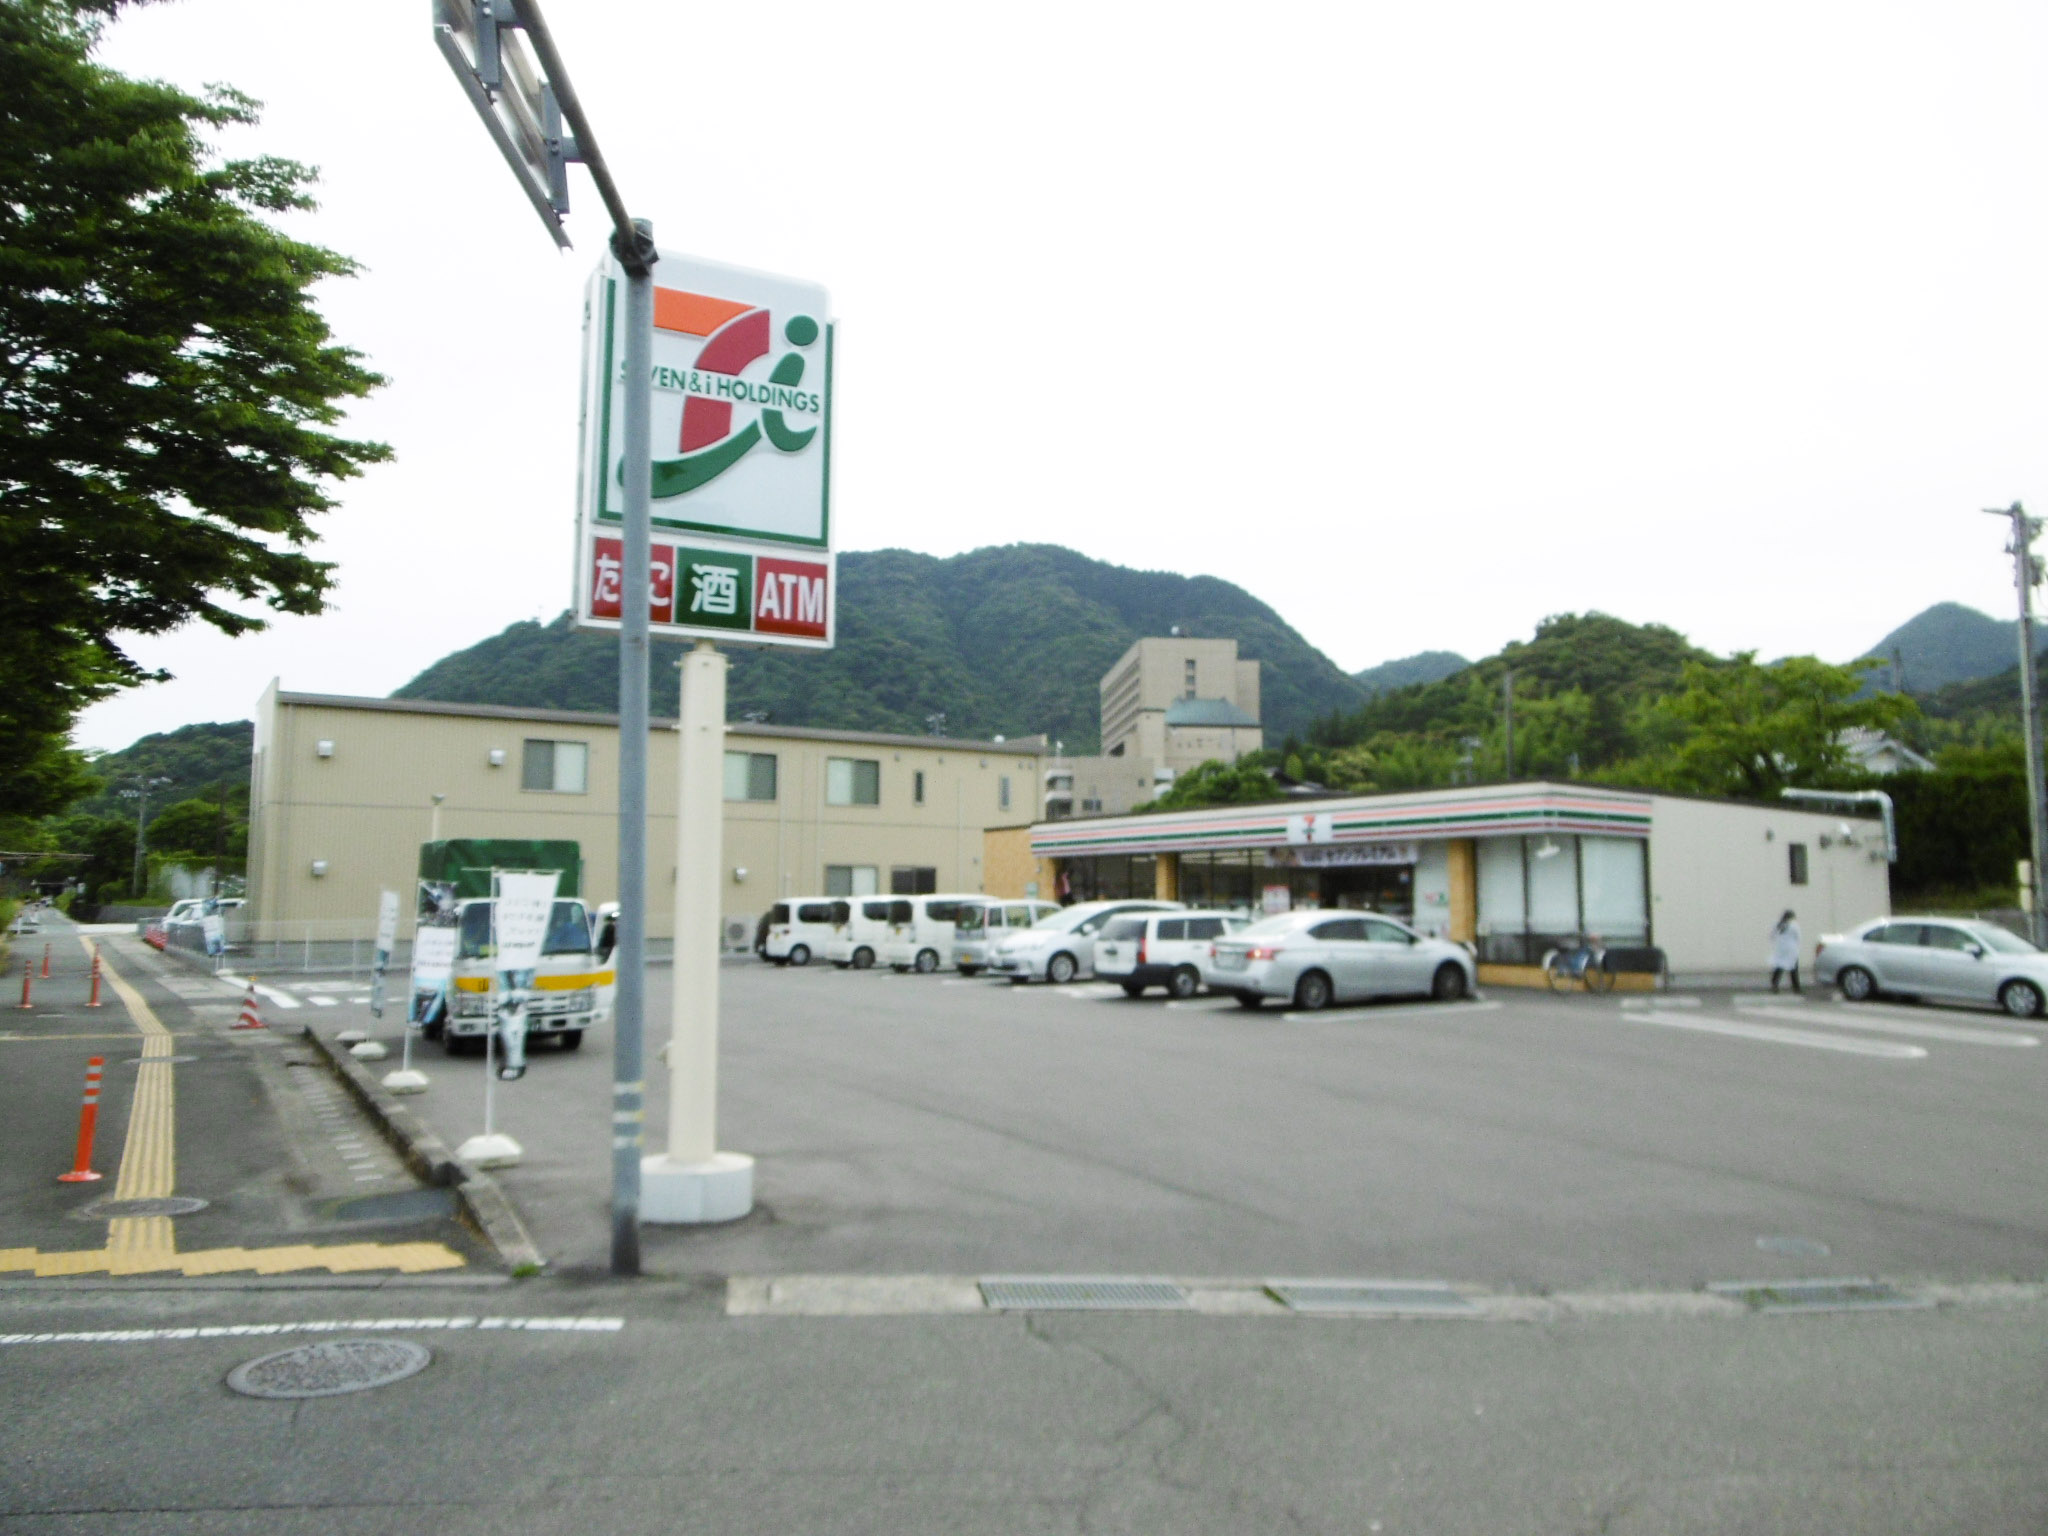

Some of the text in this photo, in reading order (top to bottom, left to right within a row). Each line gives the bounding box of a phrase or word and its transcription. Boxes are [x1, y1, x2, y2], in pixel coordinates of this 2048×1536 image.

[716, 378, 819, 413] HOLDINGS
[690, 563, 739, 614] 酒
[757, 571, 824, 624] ATM
